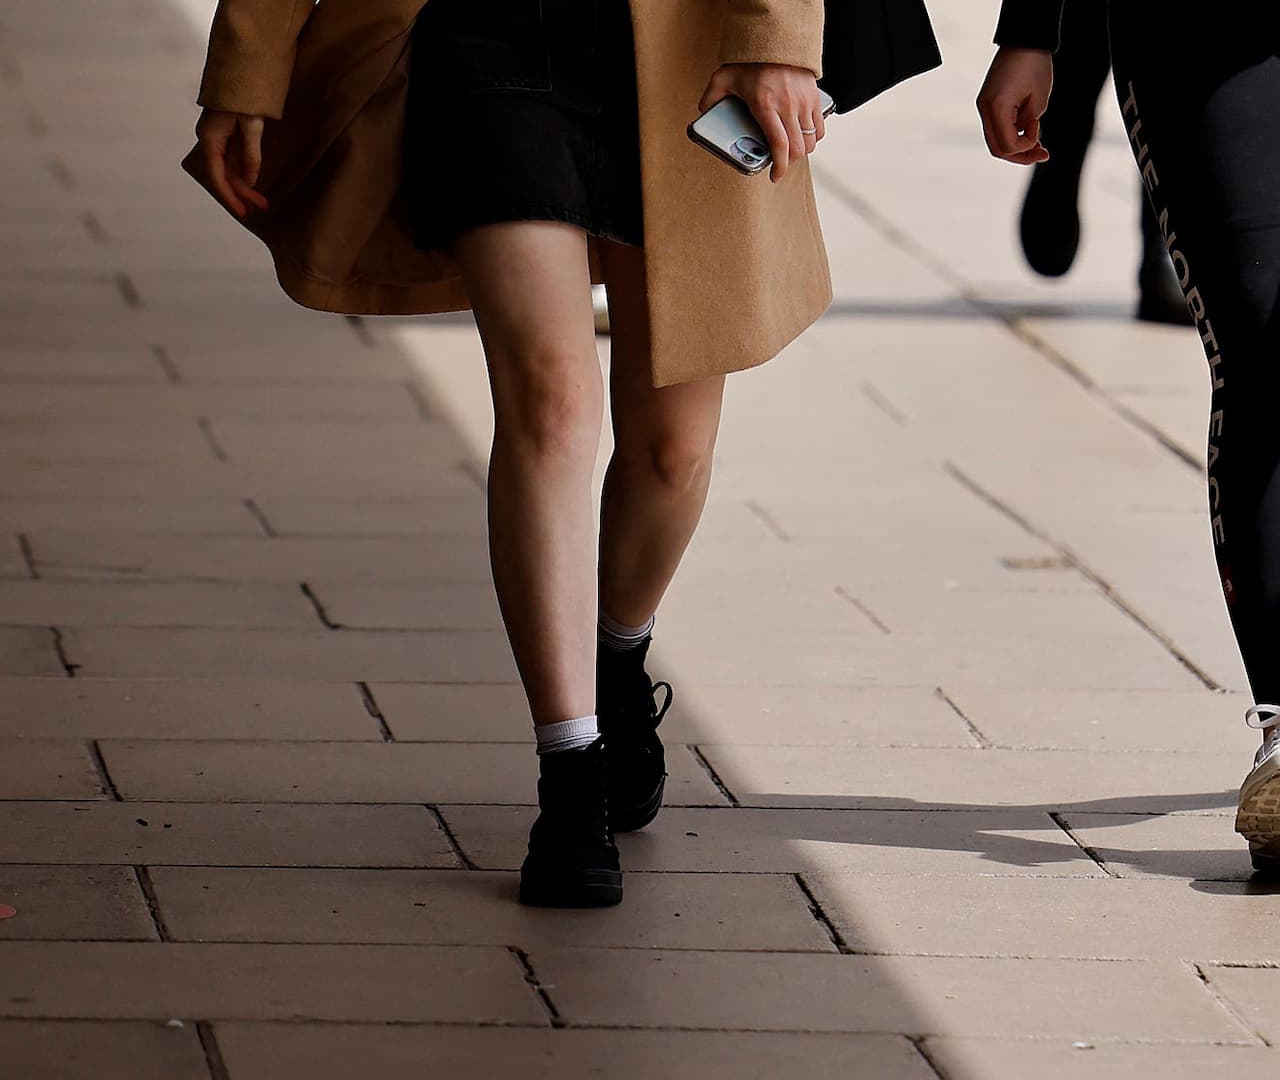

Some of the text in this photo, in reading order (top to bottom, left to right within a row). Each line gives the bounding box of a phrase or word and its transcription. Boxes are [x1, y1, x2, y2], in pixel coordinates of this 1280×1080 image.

[1123, 80, 1225, 546] THE NORTH FACE
